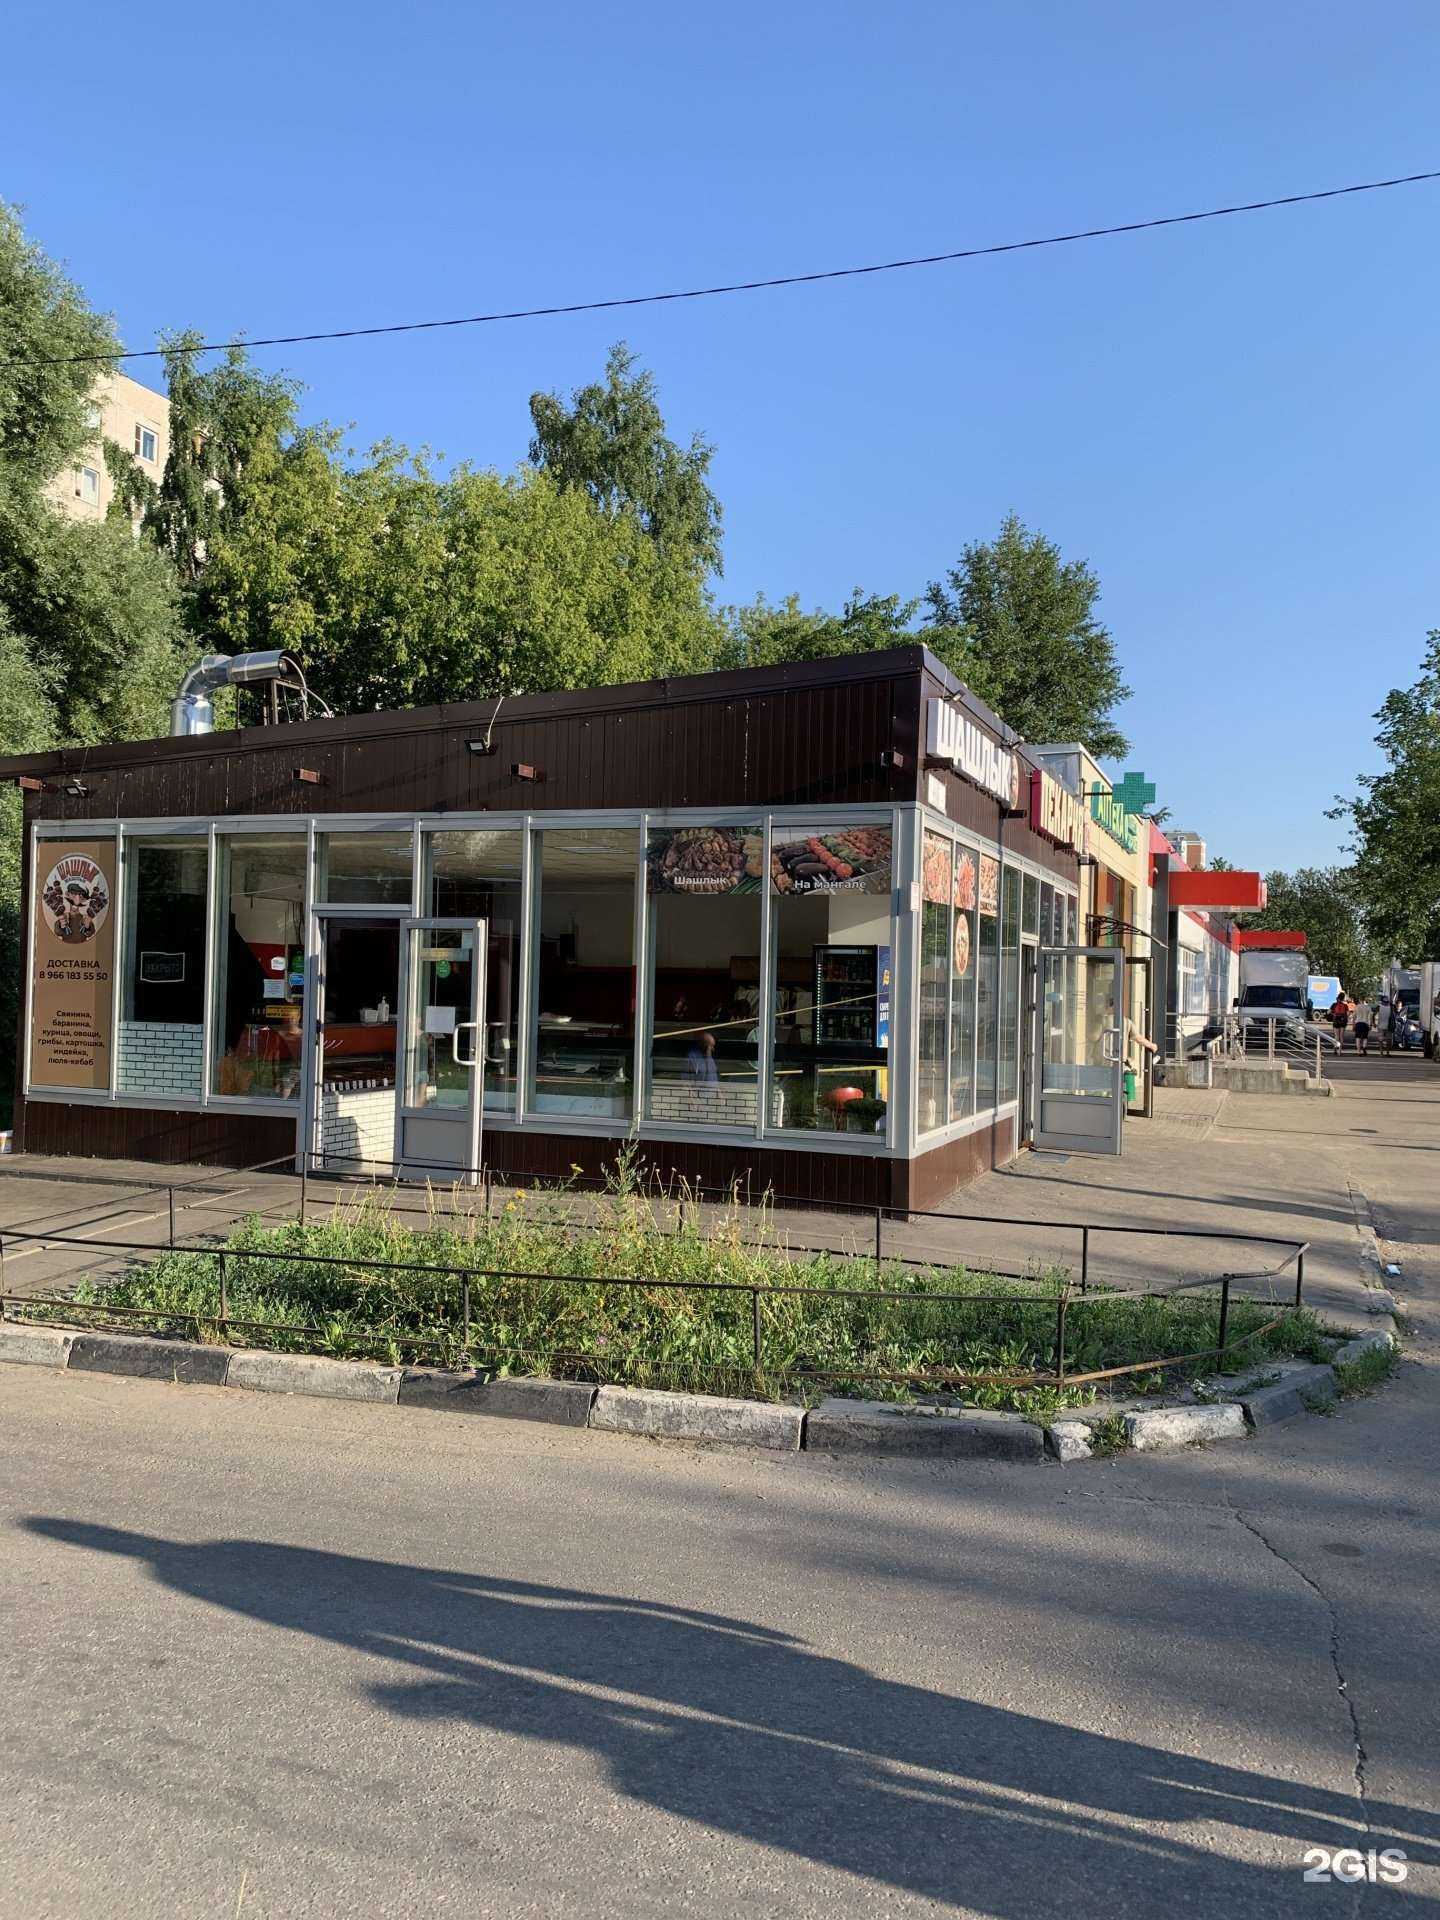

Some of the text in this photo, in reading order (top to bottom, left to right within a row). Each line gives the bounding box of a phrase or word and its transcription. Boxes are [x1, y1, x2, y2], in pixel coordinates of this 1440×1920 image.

[936, 697, 1012, 803] ШАШЛЫК
[1040, 769, 1085, 855] ПЕКАРНЯ
[673, 876, 727, 885] Шашлык
[794, 880, 866, 889] На мангале
[47, 959, 101, 969] ДОСТАВКА
[39, 971, 108, 981] 8 966 183 55 50
[56, 1010, 92, 1019] Свинина,
[42, 1029, 72, 1037] курица,
[65, 1039, 106, 1048] картошка,
[53, 1048, 89, 1057] индейка,
